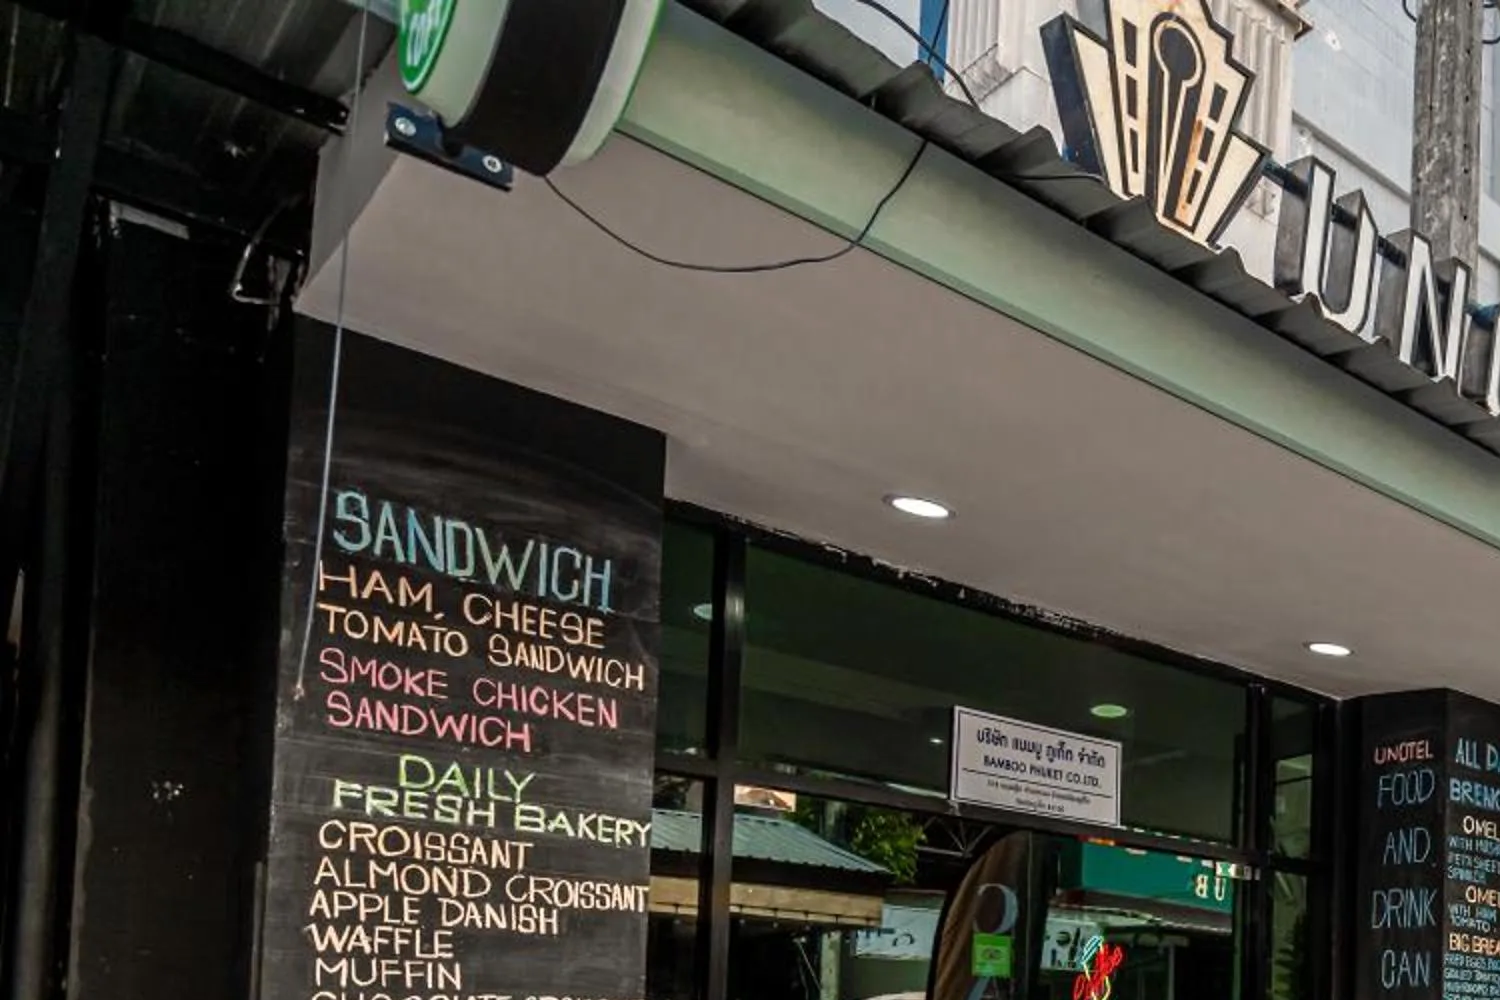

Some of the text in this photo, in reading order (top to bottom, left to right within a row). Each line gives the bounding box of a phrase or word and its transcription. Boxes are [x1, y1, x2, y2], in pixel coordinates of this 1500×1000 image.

[333, 490, 613, 612] SANDWICH
[463, 593, 606, 648] CHEESE
[318, 603, 644, 691] TOMATO SANDWICH
[320, 647, 618, 729] SMOKE CHICKEN
[326, 690, 532, 753] SANDWICH
[983, 755, 1026, 773] BAMBOO
[1030, 765, 1063, 783] PHUKET
[1374, 739, 1434, 765] UNOTEL
[1455, 737, 1480, 770] ALL
[399, 755, 535, 803] DAILY
[1377, 769, 1435, 809] FOOD
[333, 779, 652, 849] FRESH BAKERY
[318, 819, 534, 871] CROISSANT
[314, 856, 650, 913] ALMOND CROISSANT
[309, 889, 558, 935] APPLE DANISH
[1372, 887, 1437, 930] DRINK
[306, 924, 454, 959] WAFFLE
[1449, 933, 1471, 953] BIG
[315, 958, 462, 990] MUFFIN
[1381, 949, 1431, 989] CAN
